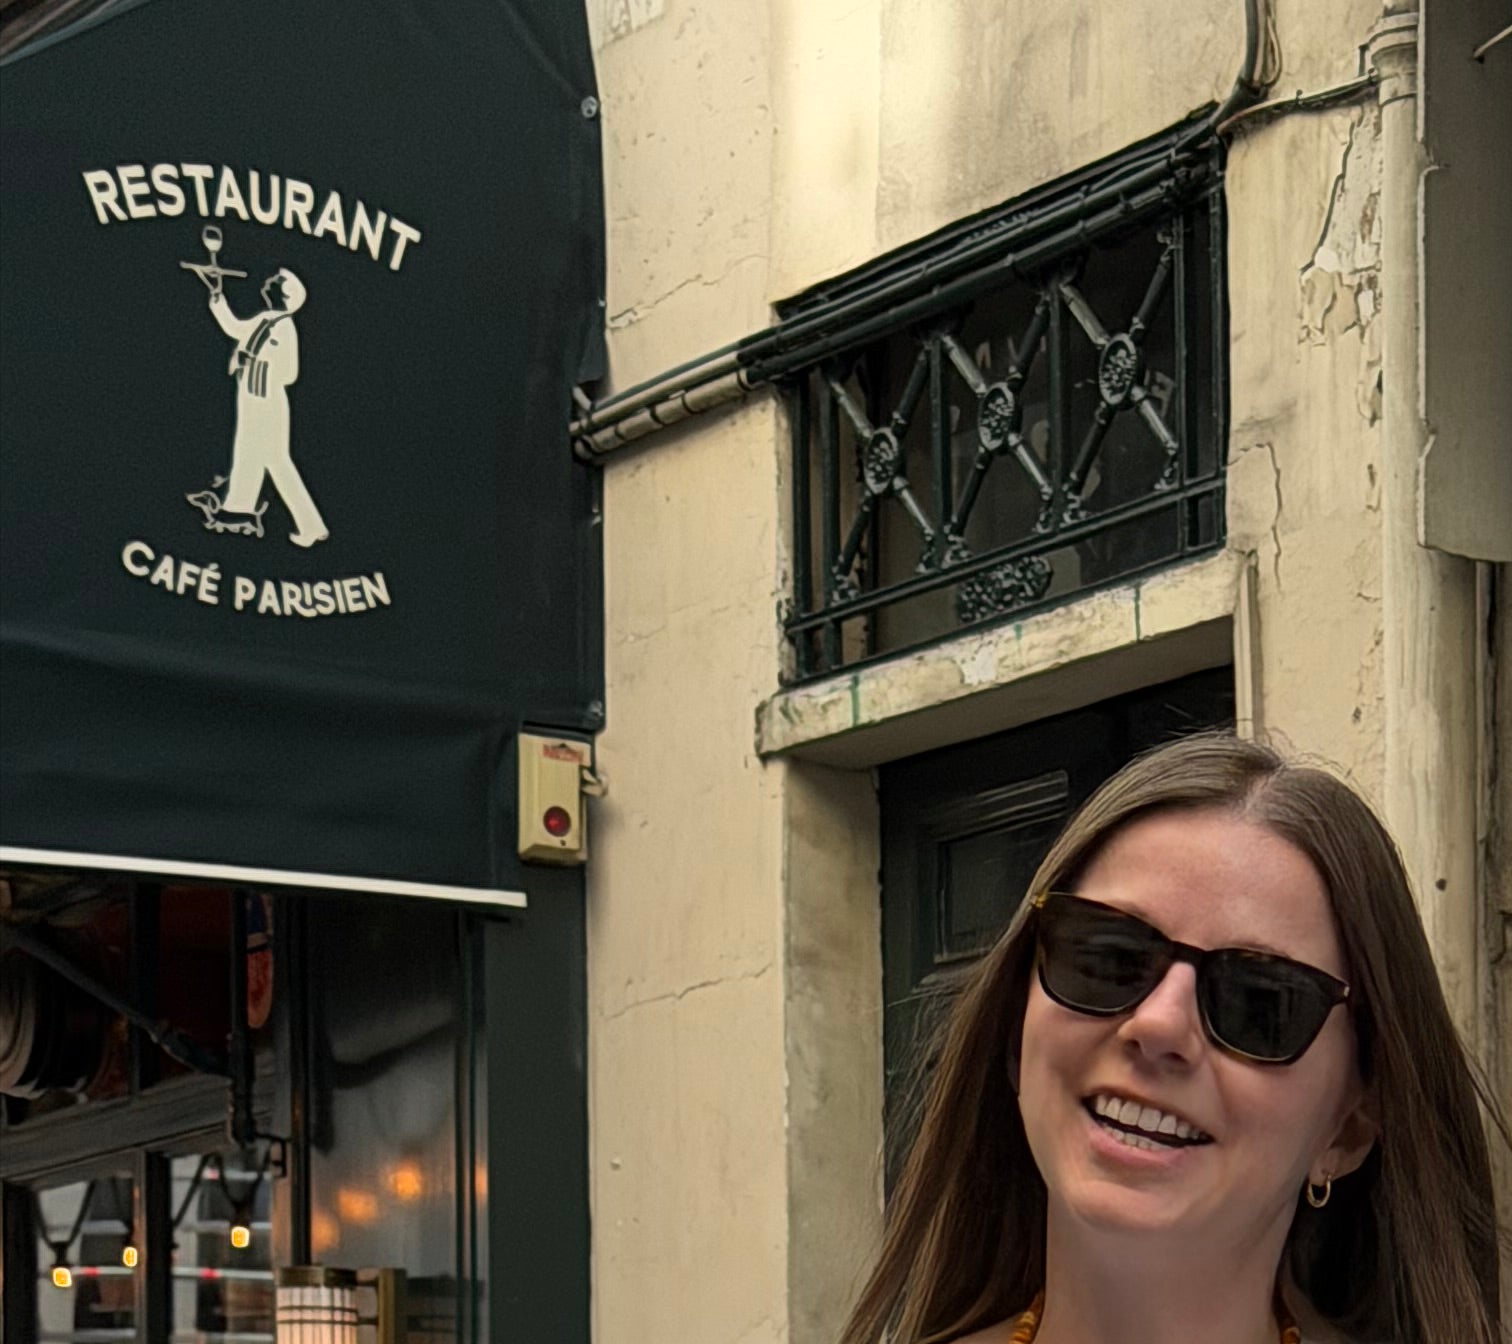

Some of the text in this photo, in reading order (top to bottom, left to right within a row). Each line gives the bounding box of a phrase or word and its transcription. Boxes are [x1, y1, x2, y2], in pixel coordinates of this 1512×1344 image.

[82, 162, 421, 271] RESTAURANT
[122, 541, 391, 618] CAFÉ PARISIEN
